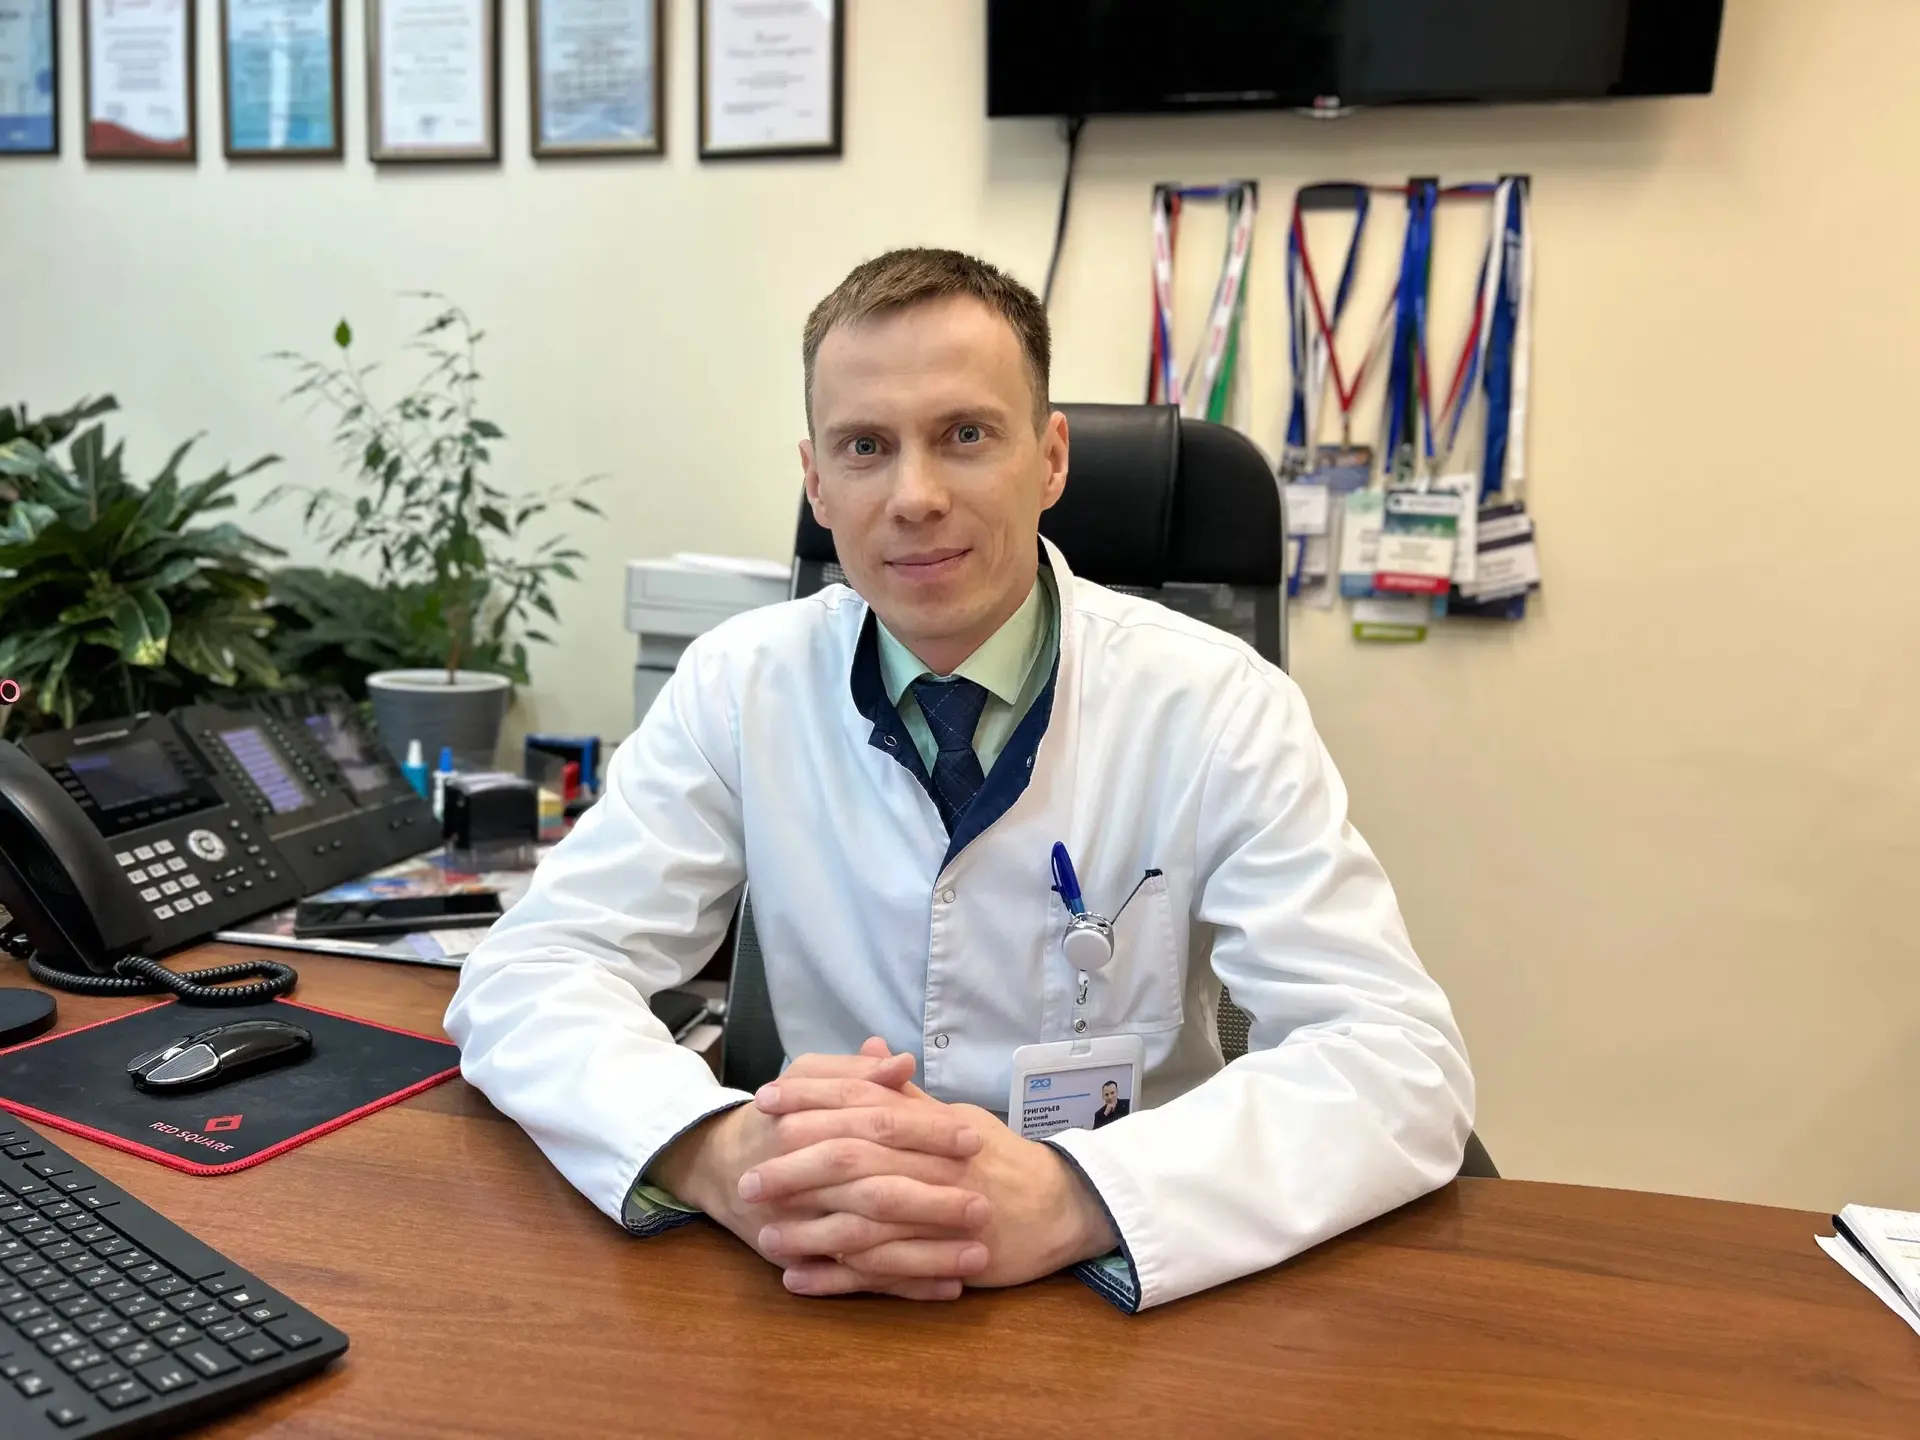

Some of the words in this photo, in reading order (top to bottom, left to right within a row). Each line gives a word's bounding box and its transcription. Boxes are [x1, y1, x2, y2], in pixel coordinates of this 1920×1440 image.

[1023, 1105, 1060, 1115] ГРИГОРЬЕВ
[1023, 1114, 1048, 1122] Евгений
[1023, 1119, 1069, 1129] Александрович
[149, 1121, 179, 1134] RED
[176, 1131, 235, 1153] SQUARE
